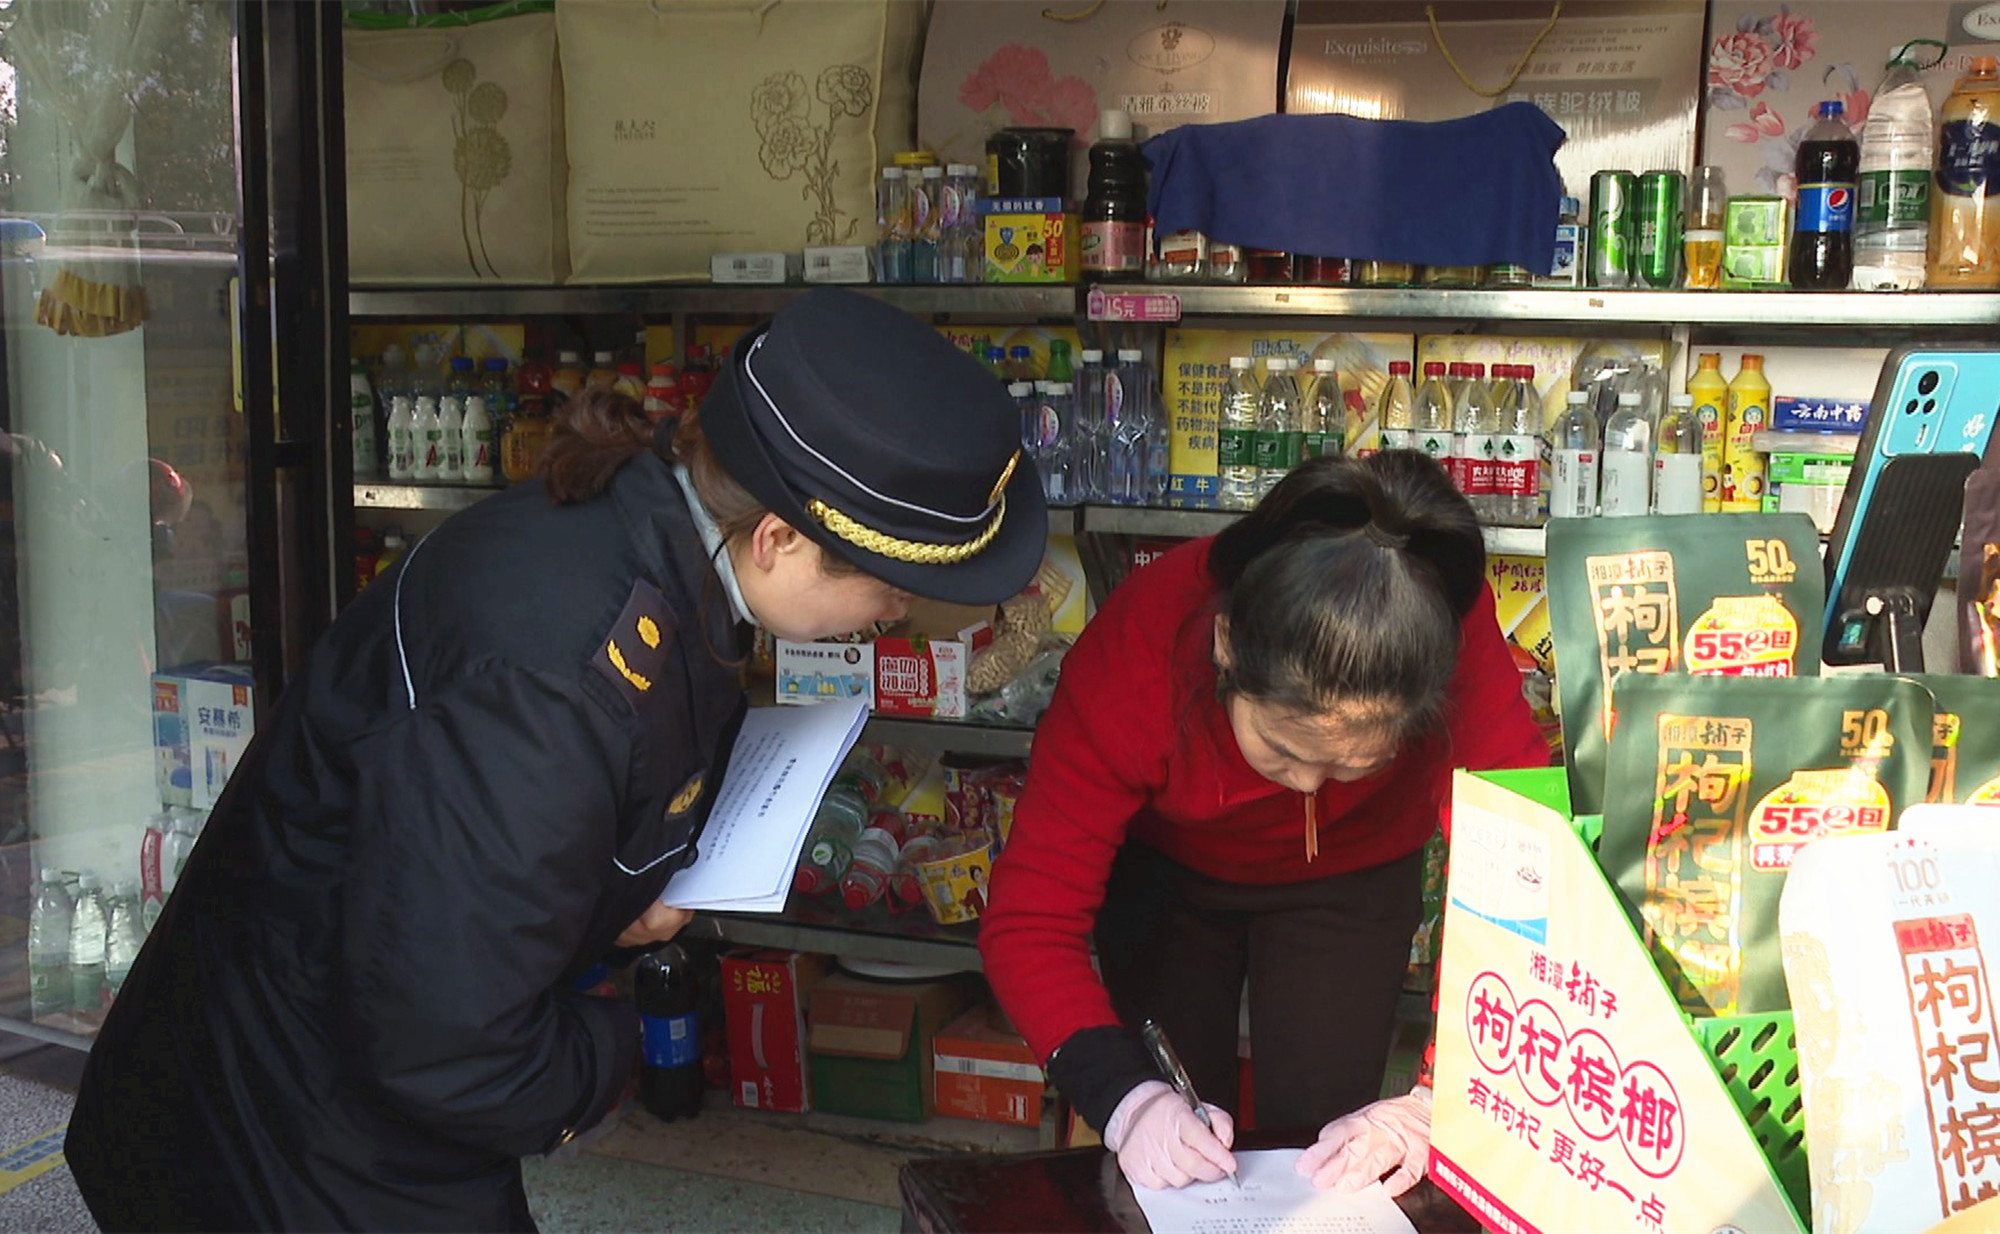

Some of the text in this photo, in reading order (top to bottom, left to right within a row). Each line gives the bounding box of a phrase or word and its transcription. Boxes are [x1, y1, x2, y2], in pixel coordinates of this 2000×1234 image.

[1324, 38, 1402, 57] Exquisite
[1043, 220, 1063, 238] 50
[1790, 403, 1863, 423] 云南中药
[198, 706, 241, 728] 安慕希
[1887, 858, 1941, 893] 100
[1530, 949, 1618, 1020] 湘潭铺子
[1472, 987, 1678, 1161] 枸杞槟榔
[1467, 1076, 1667, 1234] 有枸杞 更好一点
